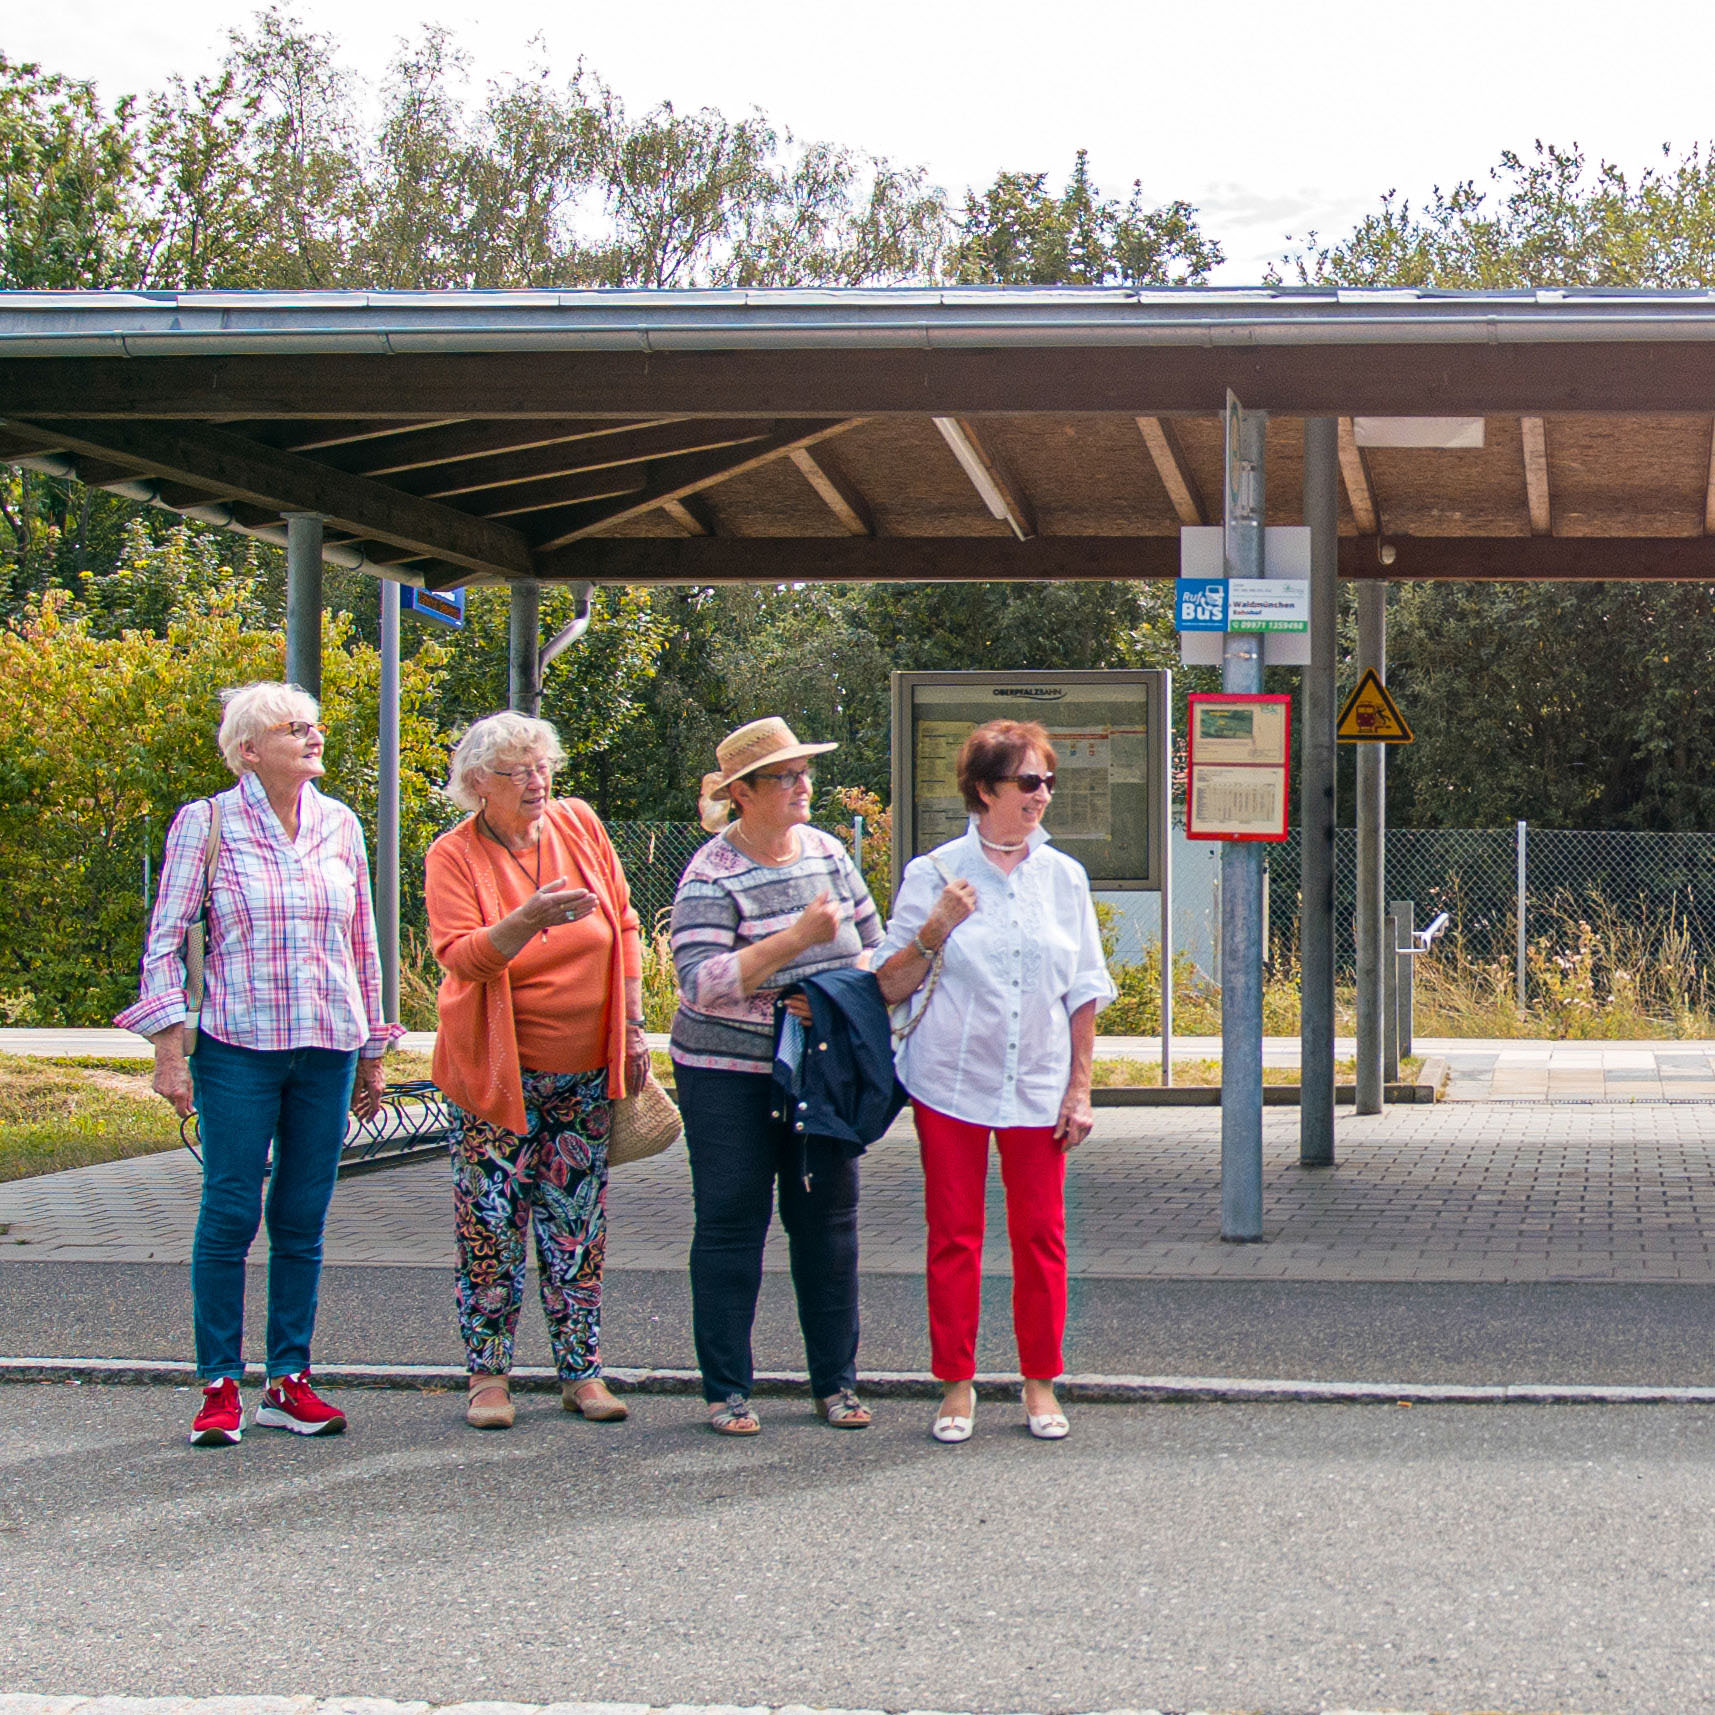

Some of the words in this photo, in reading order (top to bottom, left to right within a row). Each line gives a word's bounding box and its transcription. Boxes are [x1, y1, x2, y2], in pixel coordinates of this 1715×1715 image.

[1182, 591, 1203, 604] Ruf
[1233, 600, 1295, 609] Waldmünchen
[1181, 602, 1223, 620] Bus
[992, 688, 1062, 696] OBERPFALZBAHN
